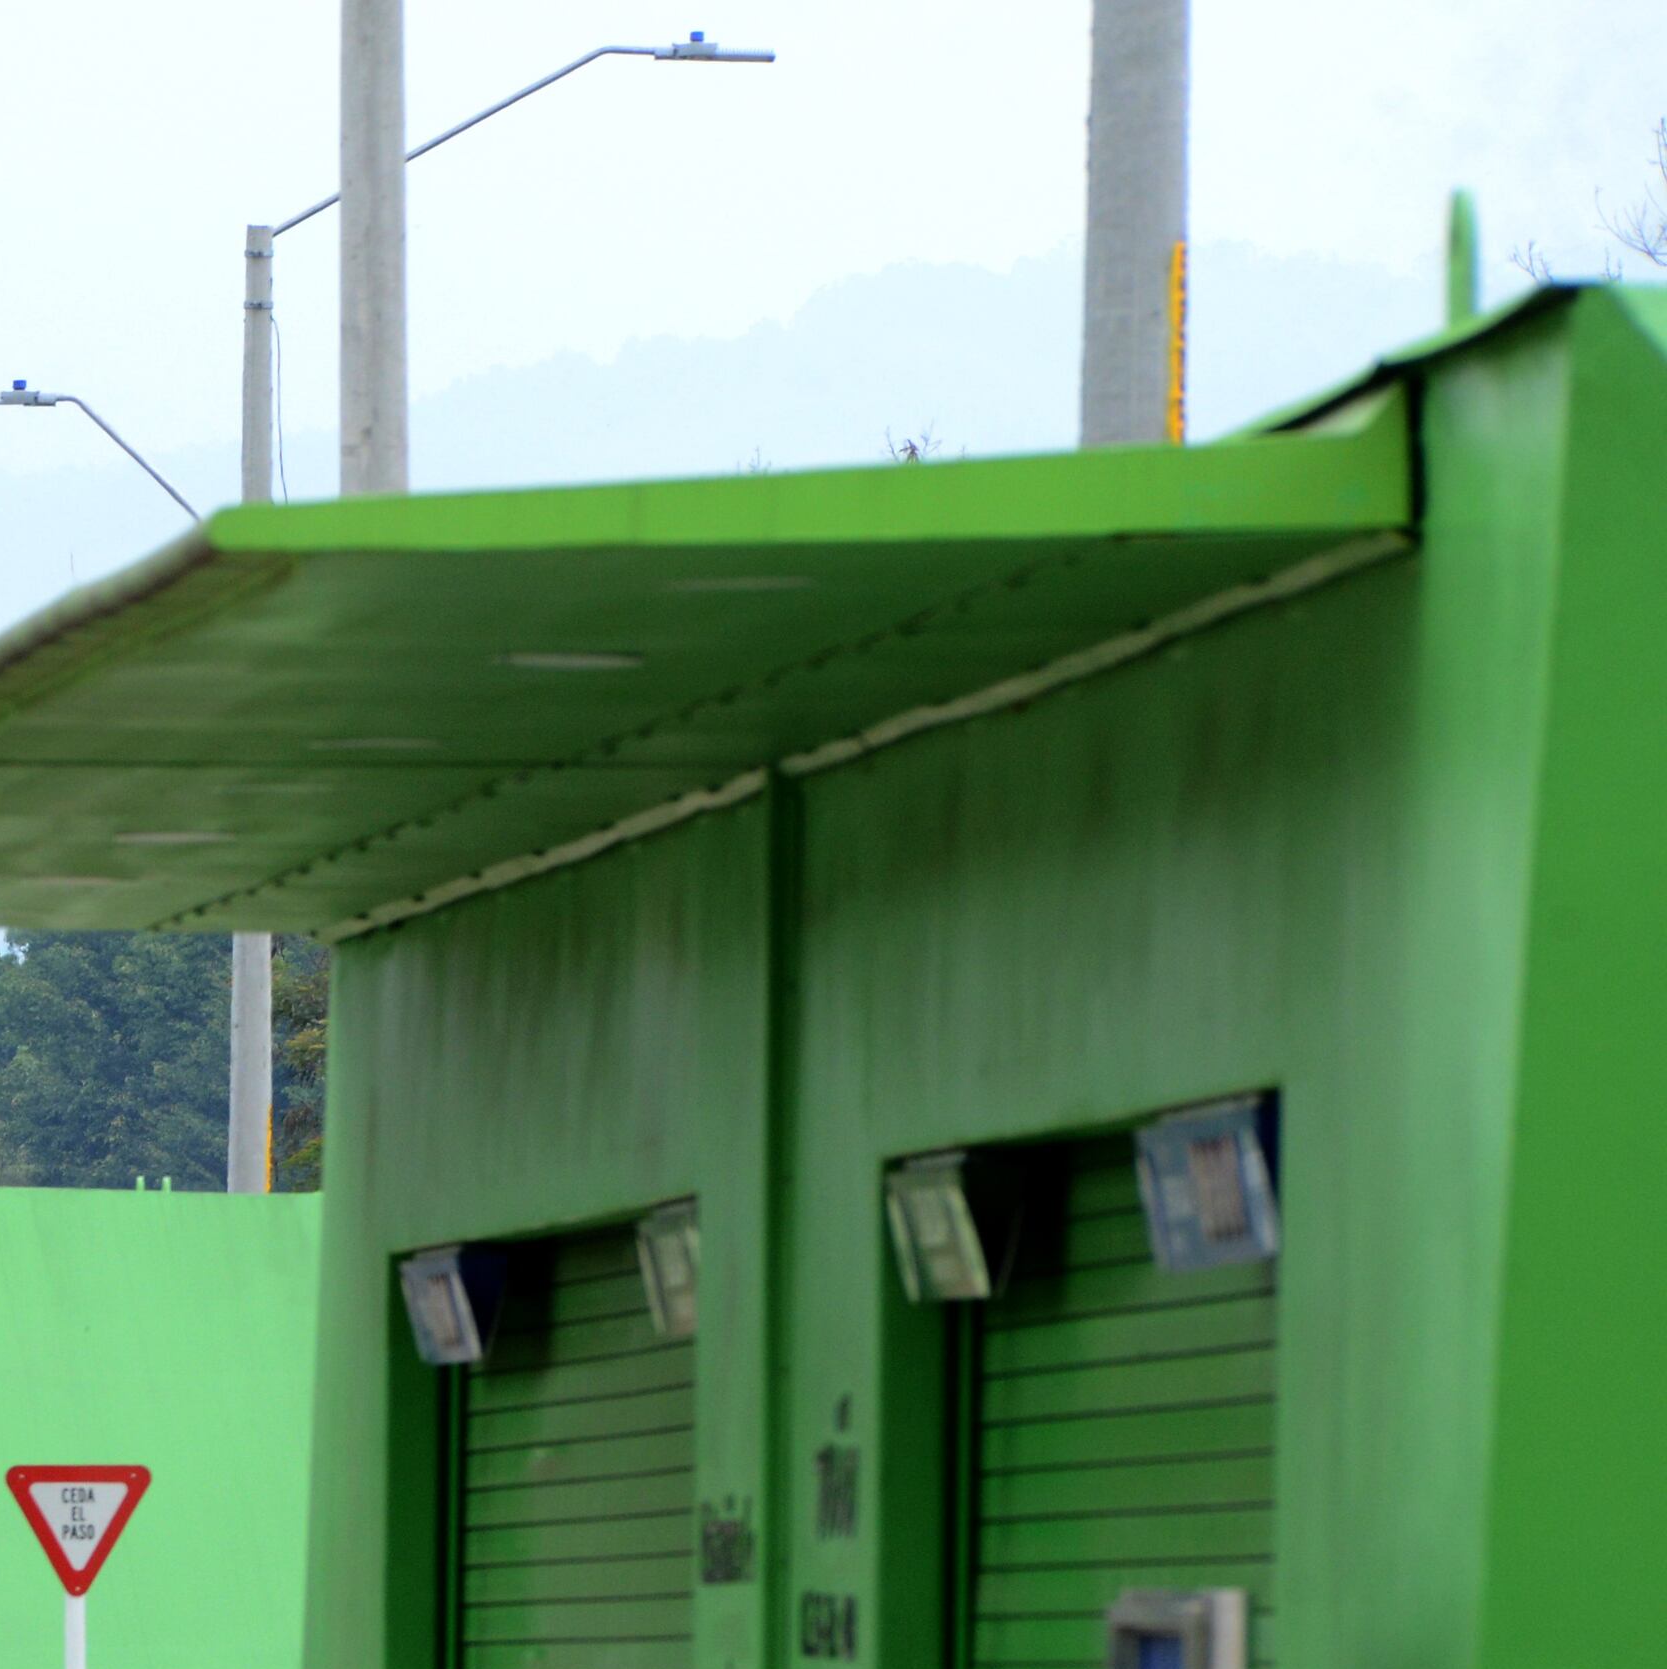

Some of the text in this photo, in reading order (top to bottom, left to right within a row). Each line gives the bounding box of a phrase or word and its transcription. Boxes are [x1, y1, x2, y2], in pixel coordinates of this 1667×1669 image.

[61, 1487, 95, 1503] CEDA
[71, 1506, 86, 1522] EL
[62, 1524, 95, 1540] PASO
